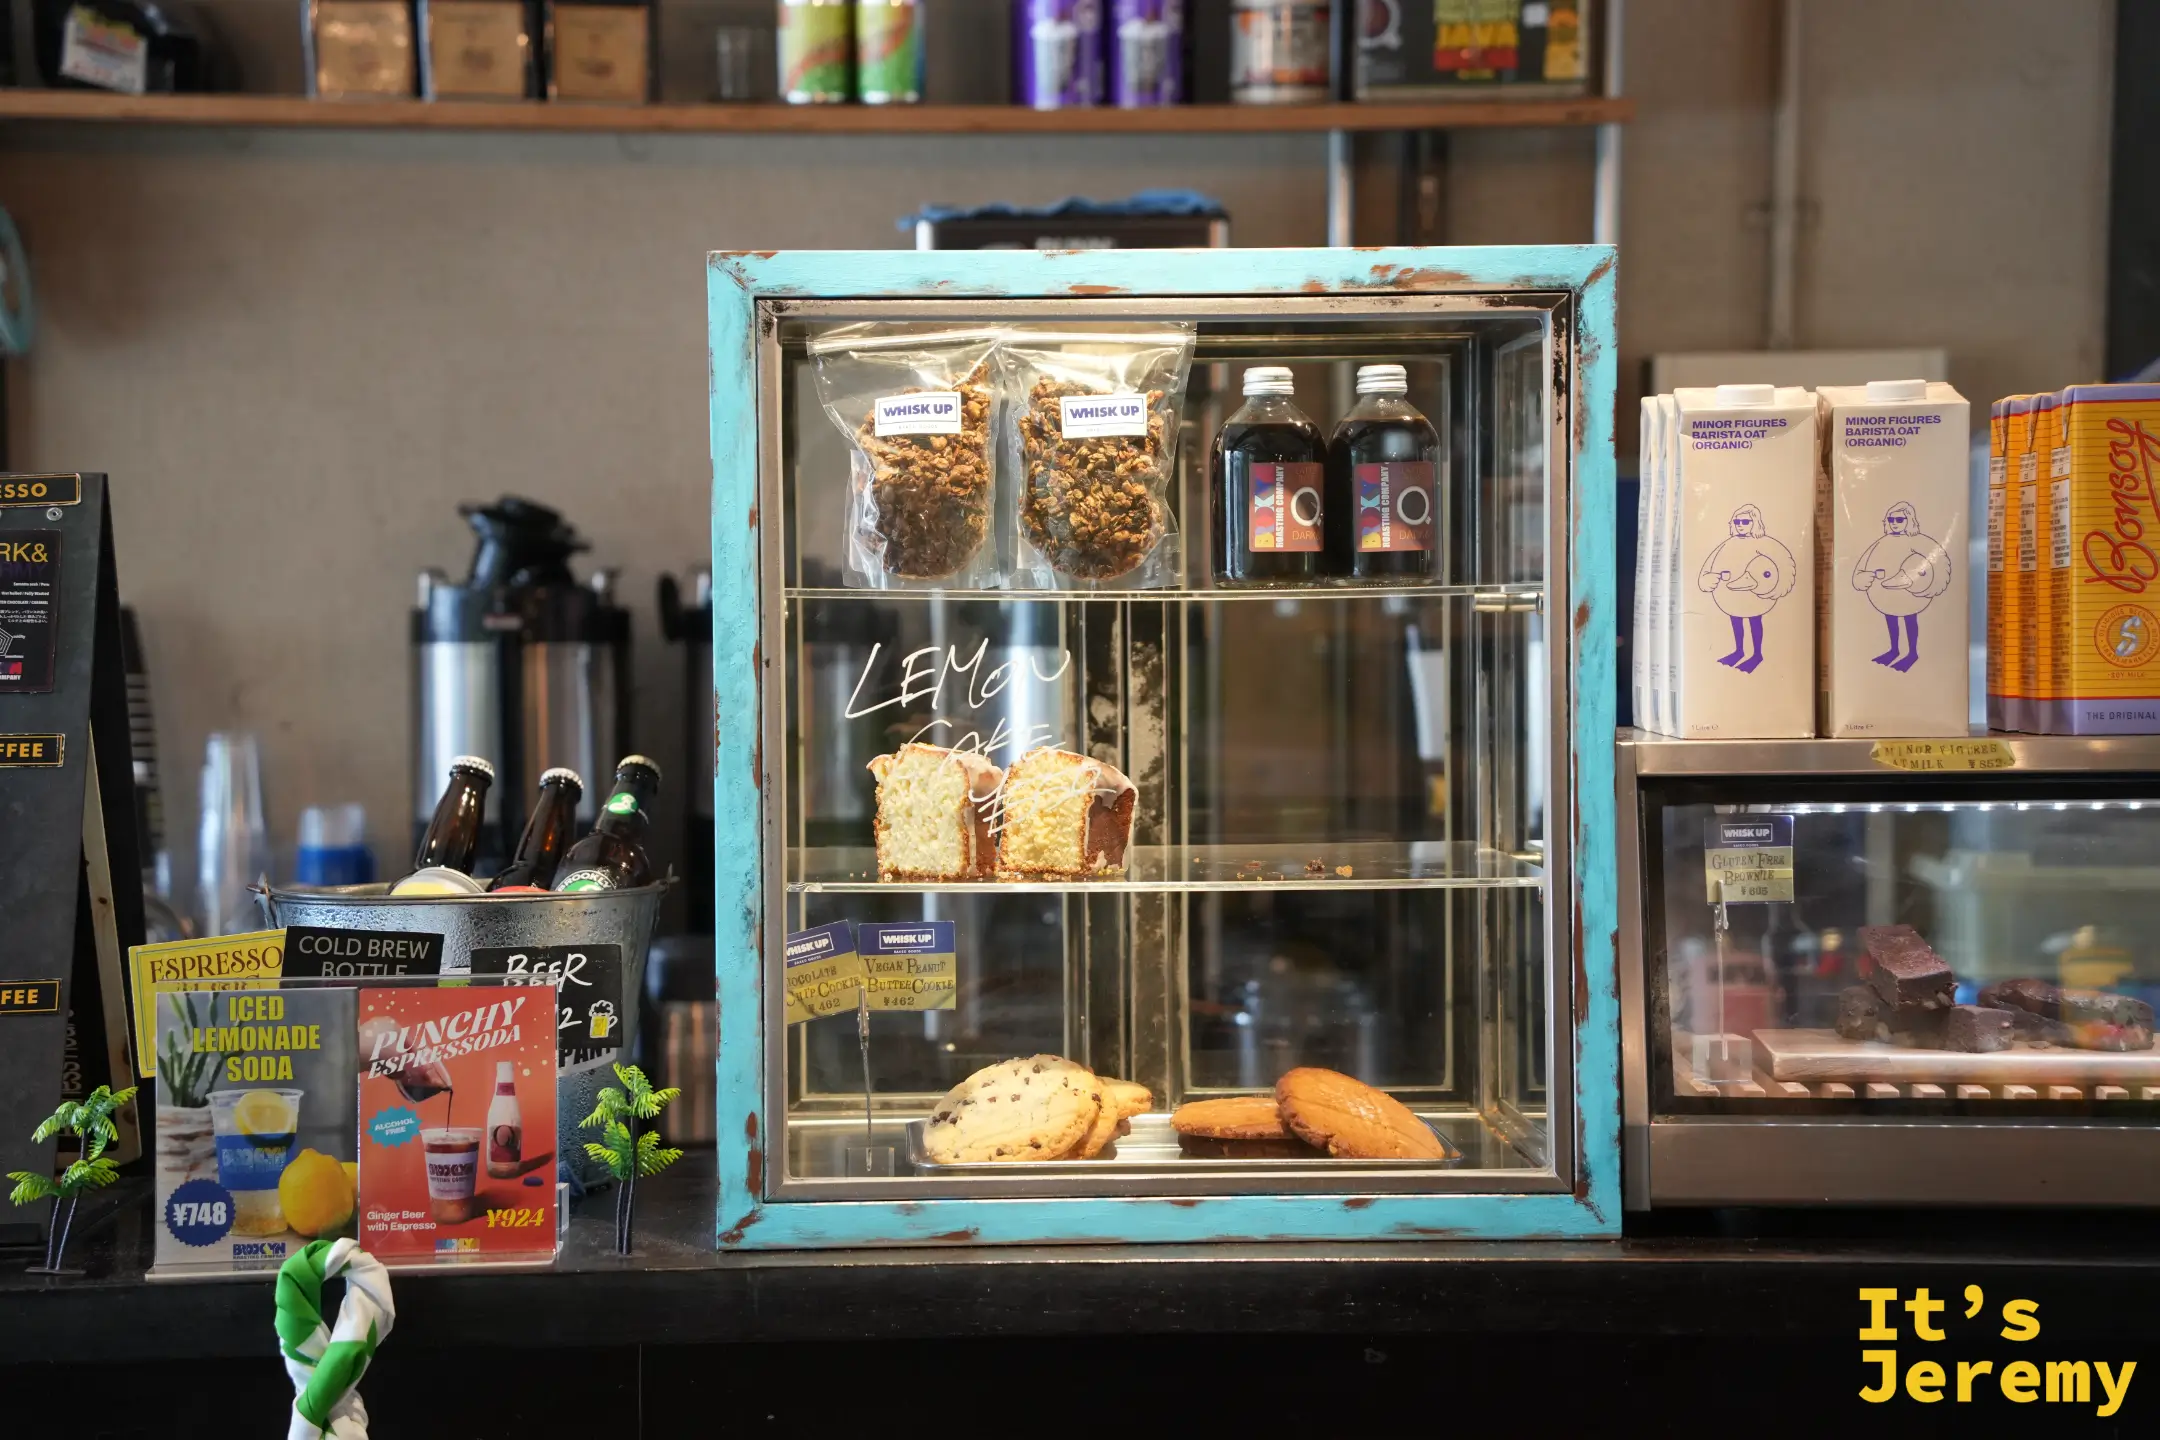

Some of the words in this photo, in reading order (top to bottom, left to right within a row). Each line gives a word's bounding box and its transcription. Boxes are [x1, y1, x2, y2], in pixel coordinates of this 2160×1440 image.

[883, 404, 930, 417] WHISK
[933, 403, 954, 414] UP
[1070, 406, 1118, 419] WHISK
[1120, 405, 1140, 417] UP
[1692, 420, 1733, 429] MINOR
[1734, 418, 1787, 428] FIGURES
[1845, 417, 1886, 426] MINOR
[1888, 415, 1941, 425] FIGURES
[1692, 429, 1742, 439] BARISTA
[1744, 429, 1767, 438] OAT
[1845, 427, 1896, 436] BARISTA
[1897, 426, 1921, 435] OAT
[1692, 440, 1753, 450] (ORGANIC)
[1845, 437, 1907, 448] (ORGANIC)
[1276, 466, 1284, 506] COMPANY
[1380, 466, 1390, 506] COMPANY
[1276, 507, 1284, 548] ROASTING
[1381, 507, 1391, 548] ROASTING
[2086, 711, 2105, 720] THE
[2109, 711, 2158, 720] ORIGINAL
[1723, 828, 1755, 838] WHISK
[1755, 828, 1770, 837] UP
[814, 938, 829, 949] UP
[882, 934, 918, 944] WHISK
[917, 934, 932, 943] UP
[299, 935, 362, 957] COLD
[368, 939, 430, 961] BREW
[150, 945, 283, 984] ESPRESSO
[229, 995, 284, 1022] ICED
[369, 996, 526, 1061] PUNCHY
[193, 1025, 321, 1053] LEMONADE
[367, 1025, 521, 1080] ESPRESSODA
[227, 1055, 294, 1082] SODA
[374, 1117, 415, 1132] ALCOHOL
[385, 1126, 407, 1136] FREE
[173, 1202, 227, 1227] ¥748
[367, 1211, 400, 1221] Ginger
[402, 1210, 426, 1219] Beer
[486, 1207, 545, 1228] ¥924
[367, 1223, 388, 1231] with
[390, 1222, 437, 1232] Espresso
